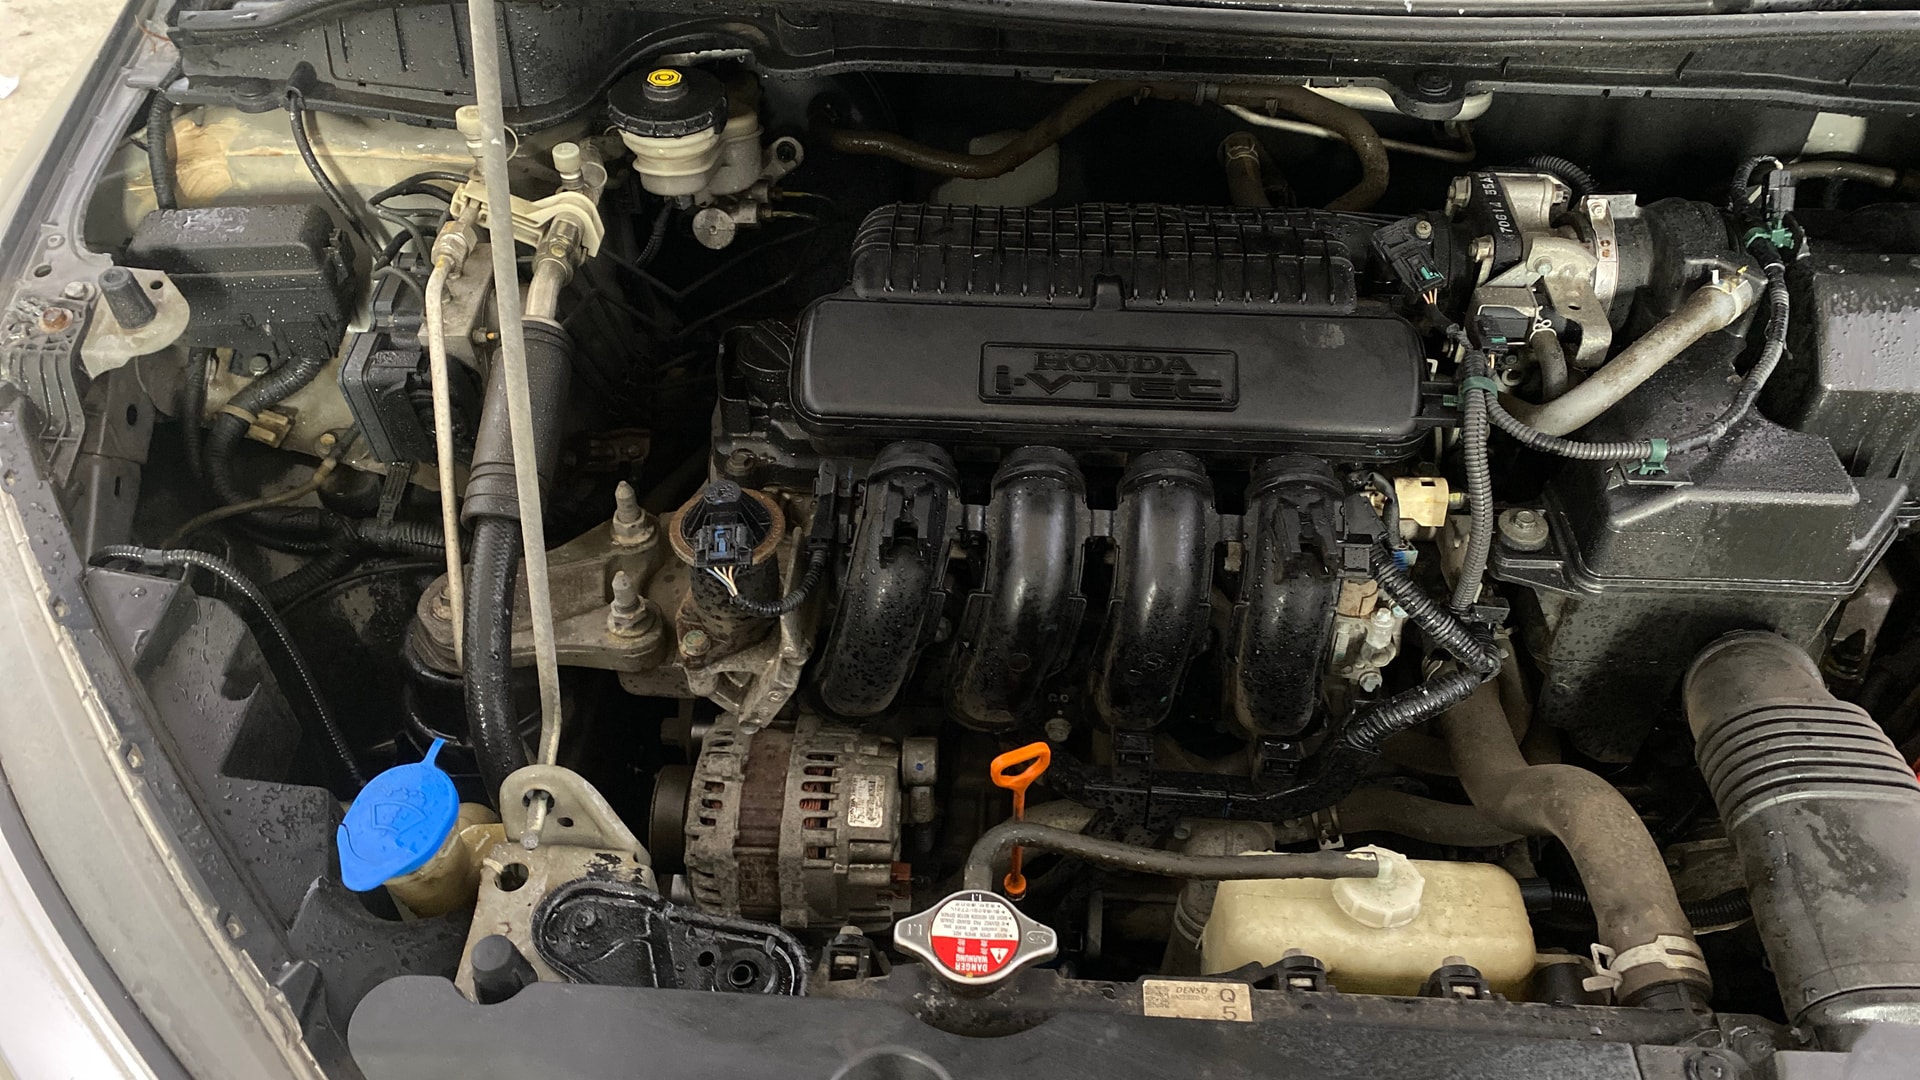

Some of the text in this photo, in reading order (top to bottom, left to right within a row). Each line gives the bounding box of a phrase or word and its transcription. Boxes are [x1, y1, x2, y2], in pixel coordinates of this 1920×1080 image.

[1034, 351, 1197, 375] HONDA
[956, 954, 988, 963] WARNUNG
[955, 963, 988, 972] DANGER
[1176, 986, 1208, 994] DENSO
[1219, 988, 1236, 1003] Q
[1222, 1006, 1238, 1020] 5
